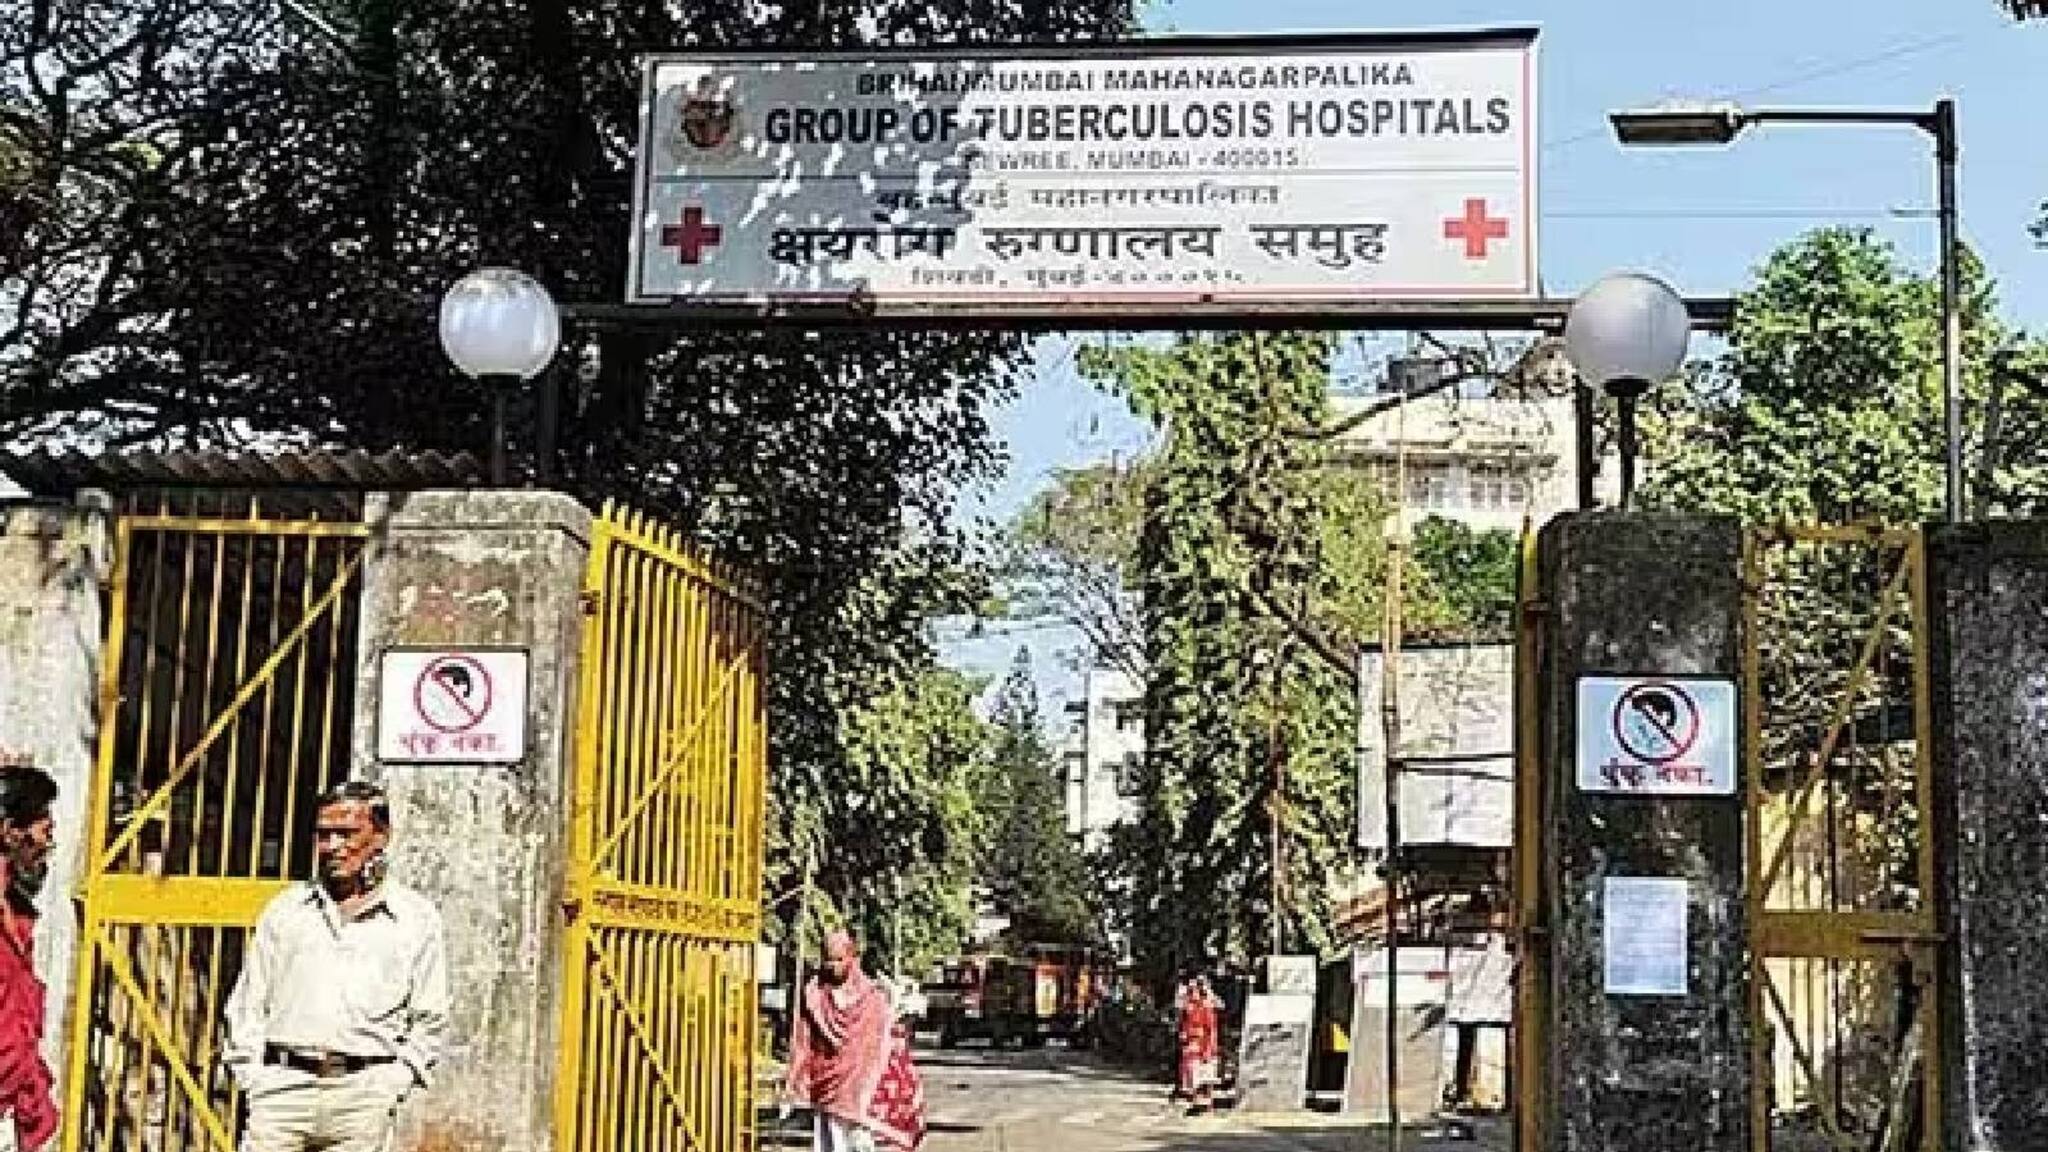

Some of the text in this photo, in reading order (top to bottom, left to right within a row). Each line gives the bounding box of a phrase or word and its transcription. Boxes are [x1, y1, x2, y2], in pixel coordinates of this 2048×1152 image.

[1104, 63, 1414, 90] MAHANAGARPALIKA
[767, 97, 1510, 143] GROUP OF TUBERCULOSIS HOSPITALS
[1087, 150, 1190, 169] MUMBAI
[980, 226, 1222, 261] रुग्णालय
